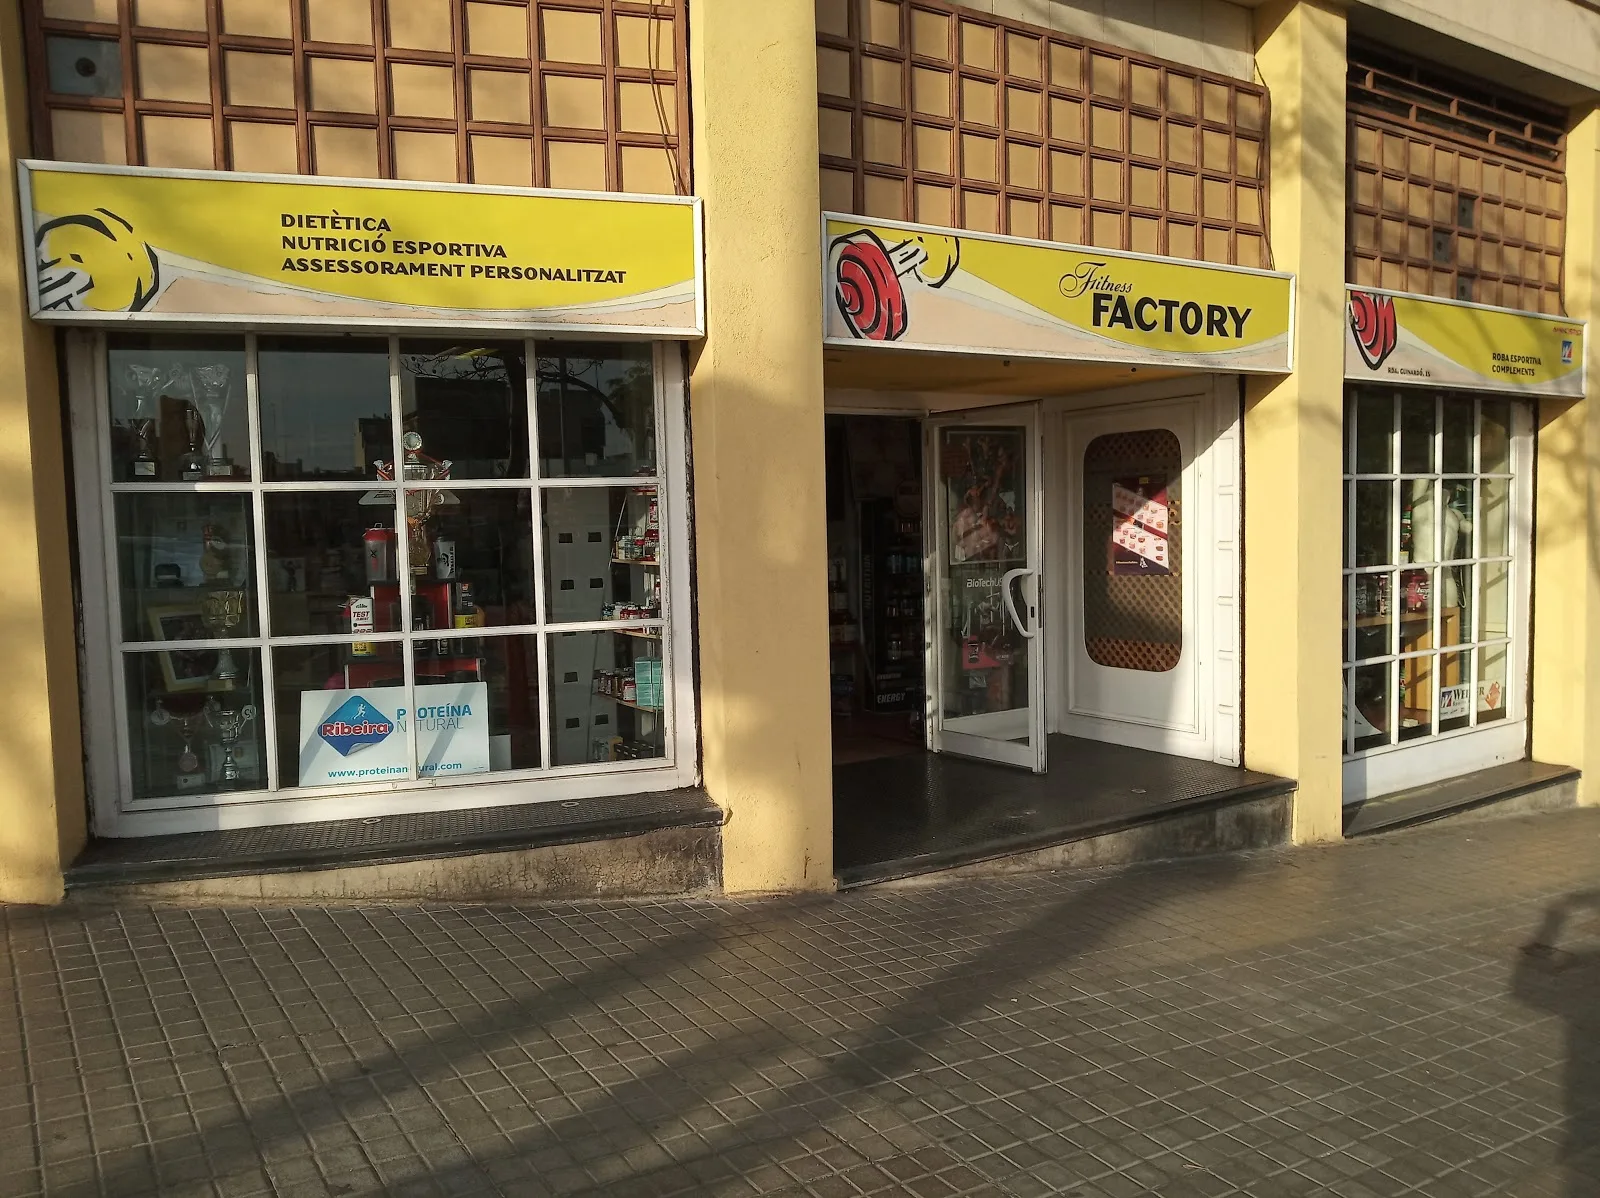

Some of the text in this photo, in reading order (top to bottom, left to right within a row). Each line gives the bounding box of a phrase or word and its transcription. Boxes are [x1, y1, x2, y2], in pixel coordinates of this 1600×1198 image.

[280, 208, 392, 232] DIETÈTICA
[280, 233, 508, 259] NUTRICIÓ ESPORTIVA
[280, 257, 627, 284] ASSESSORAMENT PERSONALITZAT
[1058, 261, 1134, 299] Fitness
[1091, 292, 1253, 339] FACTORY
[1492, 352, 1542, 366] ROBA ESPORTIVA
[1491, 364, 1536, 377] COMPLEMENTS
[352, 610, 371, 618] TEST
[396, 702, 473, 721] POTEÍNA
[321, 721, 390, 738] Ribeira
[396, 717, 464, 734] NTURAL
[327, 761, 463, 779] www.proteinanural.com
